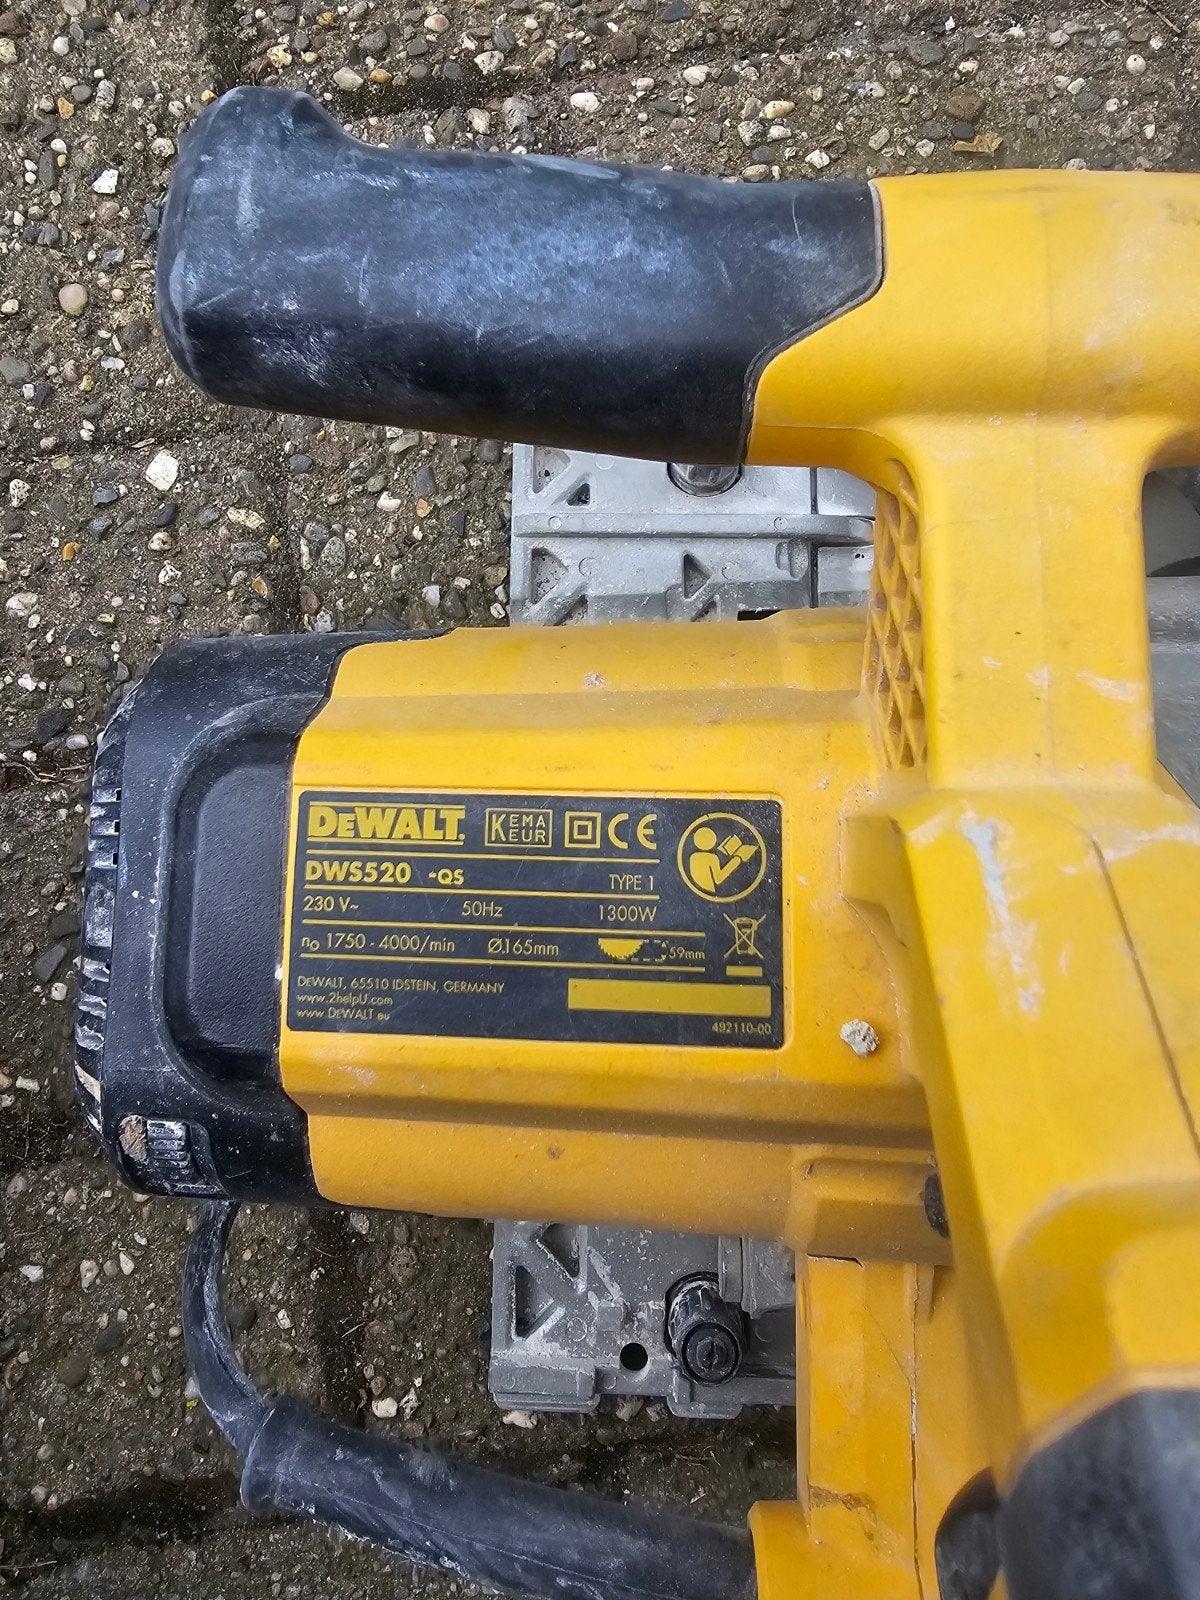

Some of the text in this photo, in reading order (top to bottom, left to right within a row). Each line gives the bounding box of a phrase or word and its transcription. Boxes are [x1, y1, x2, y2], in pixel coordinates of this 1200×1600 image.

[305, 860, 412, 884] DWS520
[609, 873, 654, 890] TYPE 1
[303, 894, 335, 912] 230
[461, 900, 503, 917] 50Hz
[599, 904, 657, 921] 1300W
[326, 932, 366, 949] 1750
[379, 934, 455, 953] 4000/min
[669, 946, 705, 960] 59mm
[350, 977, 389, 990] 65510
[443, 980, 505, 993] GERMANY
